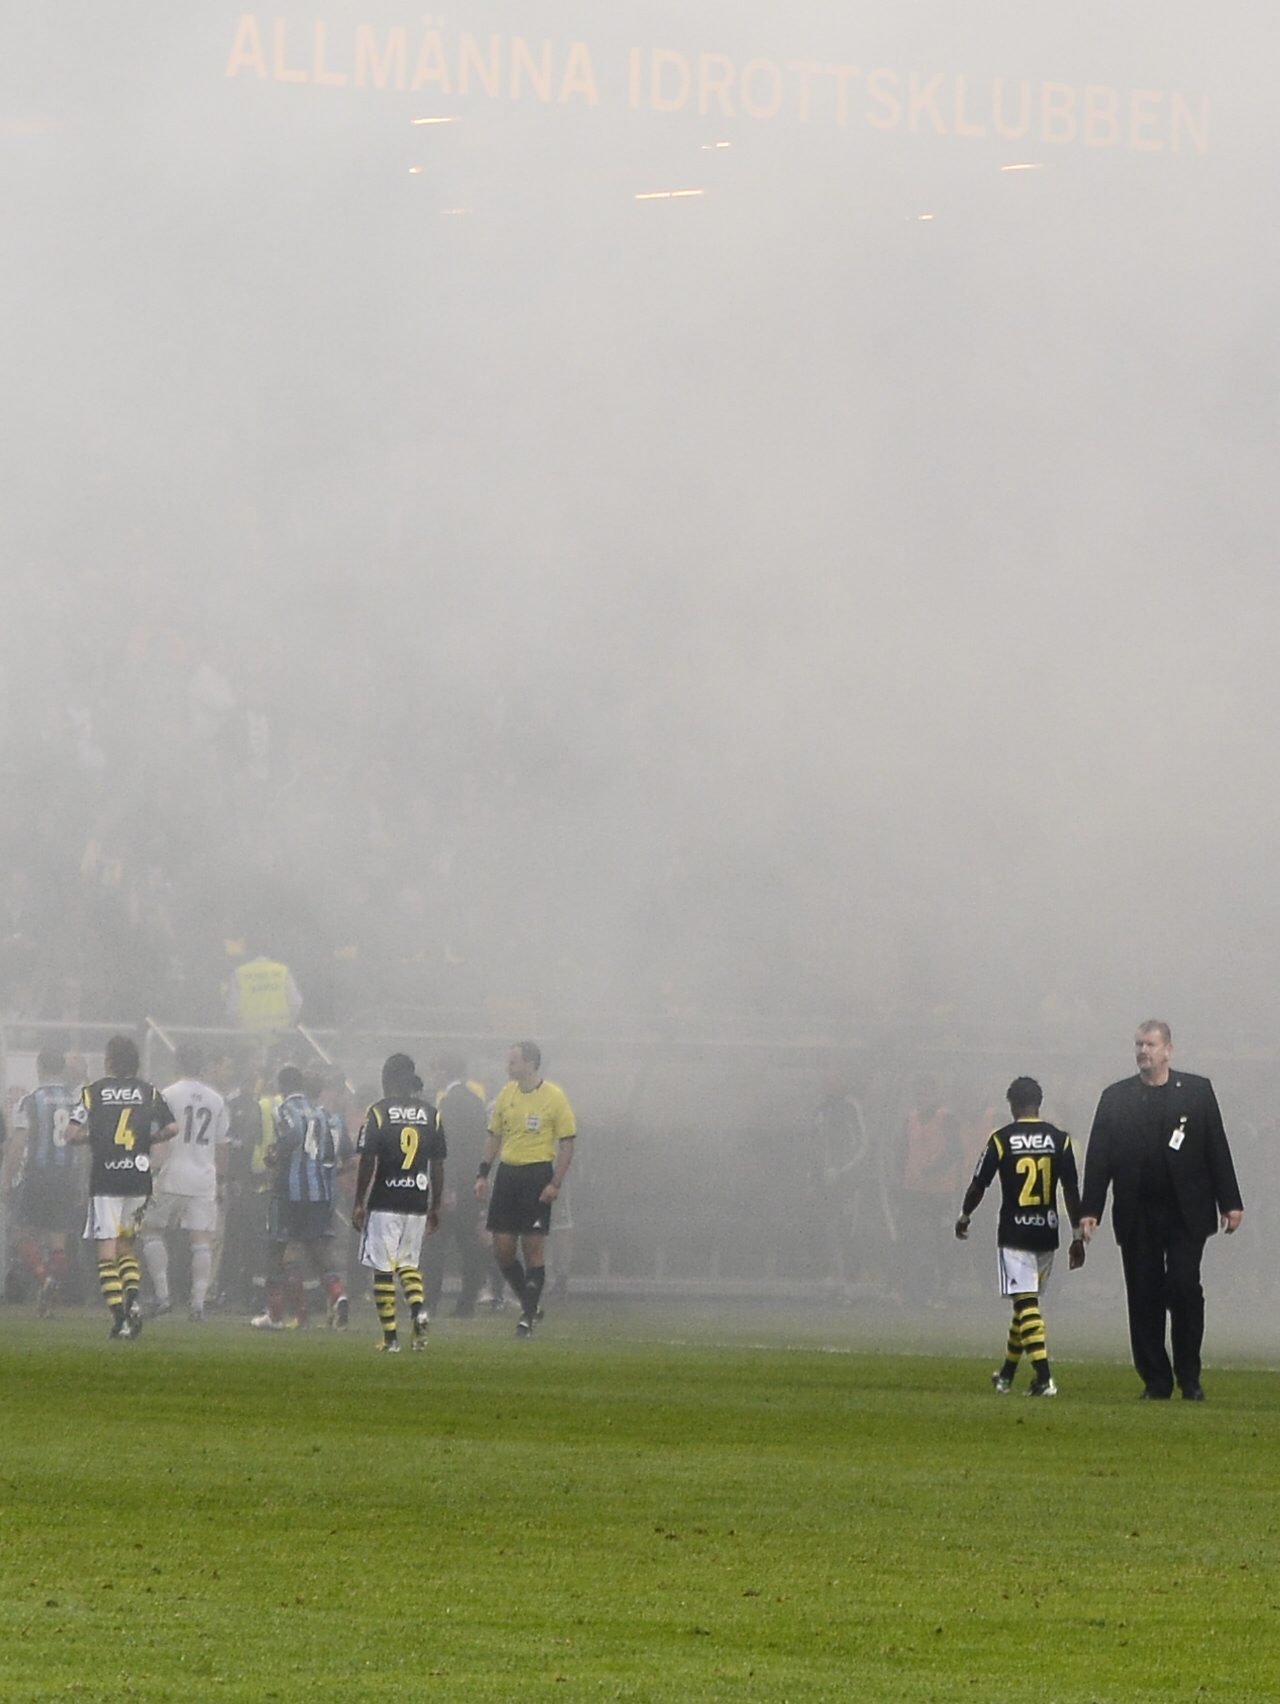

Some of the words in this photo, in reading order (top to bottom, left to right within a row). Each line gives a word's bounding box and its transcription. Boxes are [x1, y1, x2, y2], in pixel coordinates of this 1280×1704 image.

[225, 13, 600, 107] ALLMÄNNA
[627, 46, 1211, 155] IDROTTSKLUBBEN
[101, 1088, 143, 1101] SVEA
[388, 1107, 428, 1121] SVEA
[114, 1107, 135, 1151] 4
[183, 1104, 213, 1146] 12
[1009, 1135, 1055, 1149] SVEA
[400, 1126, 419, 1170] 9
[1016, 1155, 1052, 1207] 21
